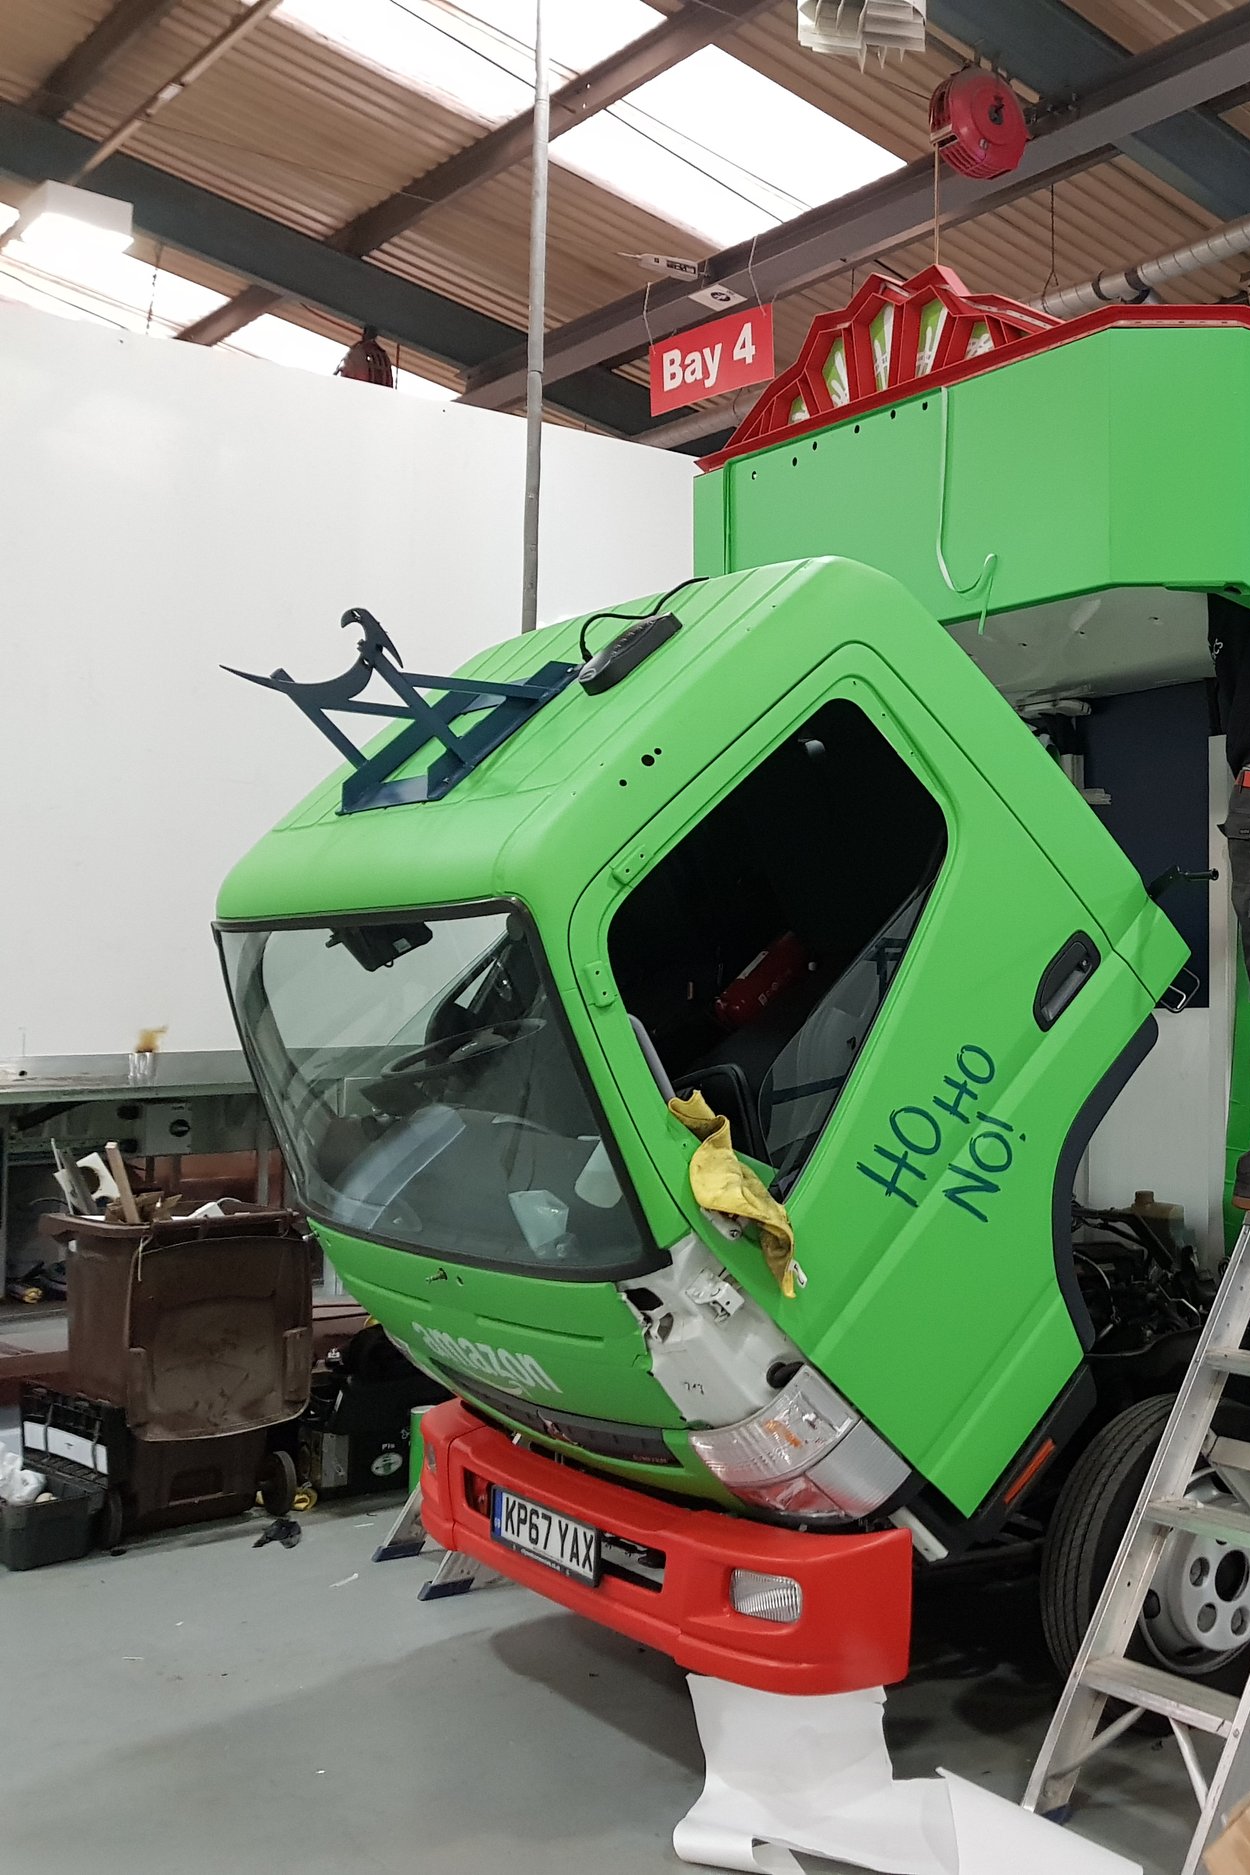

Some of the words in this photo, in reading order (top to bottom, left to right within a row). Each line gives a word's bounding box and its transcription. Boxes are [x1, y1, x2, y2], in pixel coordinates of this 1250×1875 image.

[662, 342, 723, 392] Bay
[732, 322, 756, 365] 4
[856, 1105, 942, 1208] HO
[932, 1044, 996, 1125] HO
[942, 1110, 1027, 1223] NO!
[411, 1321, 564, 1394] amazon
[505, 1496, 552, 1551] KP67
[558, 1519, 594, 1573] YAX
